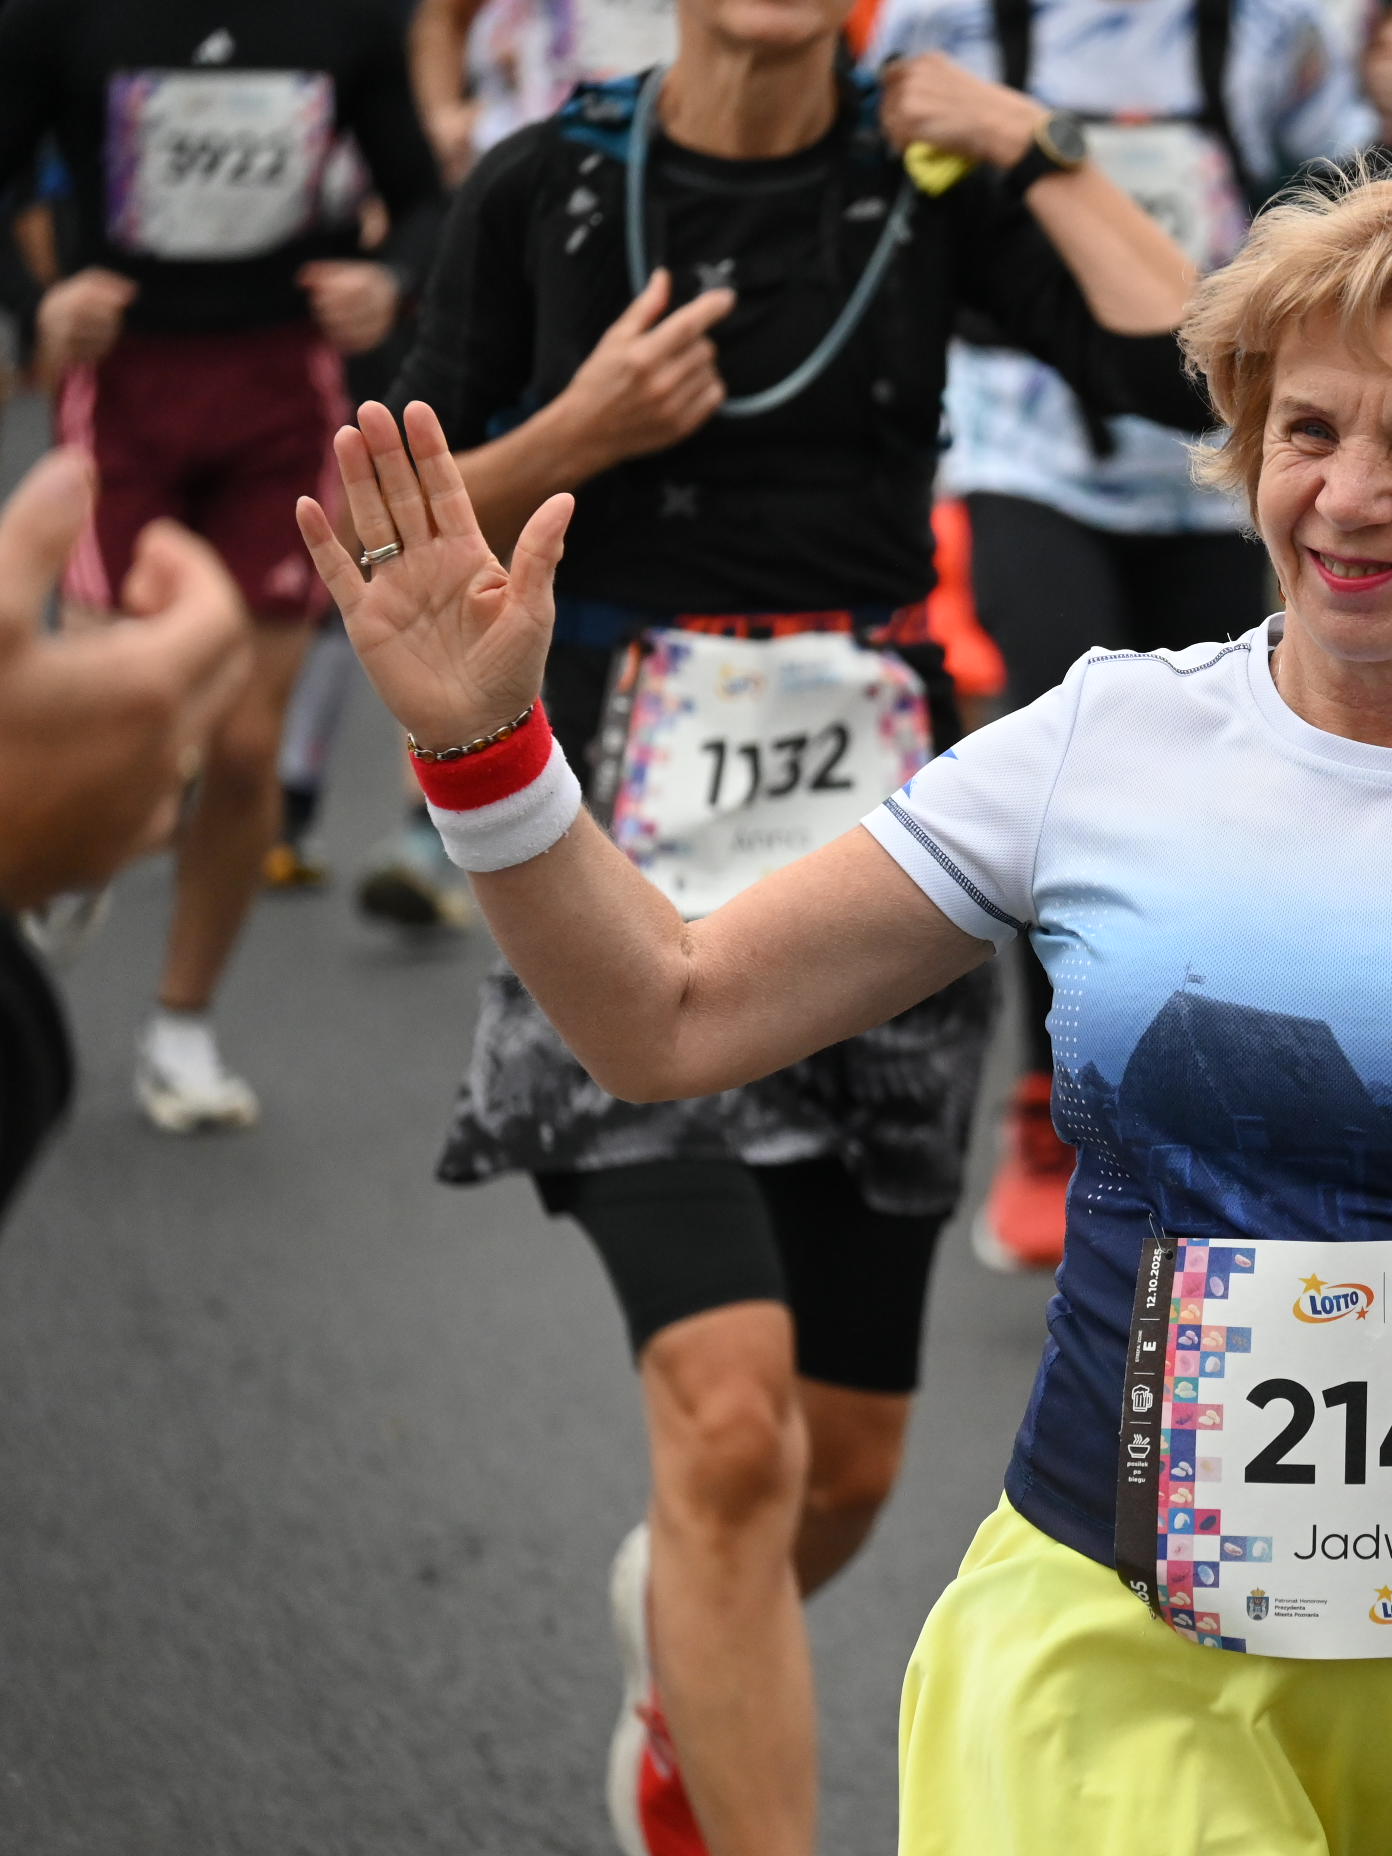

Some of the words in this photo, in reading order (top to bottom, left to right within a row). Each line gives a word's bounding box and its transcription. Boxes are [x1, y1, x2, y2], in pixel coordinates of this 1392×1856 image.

[1147, 1248, 1162, 1309] 12.10.2025
[1309, 1290, 1359, 1316] LOTTO
[1143, 1341, 1157, 1352] E
